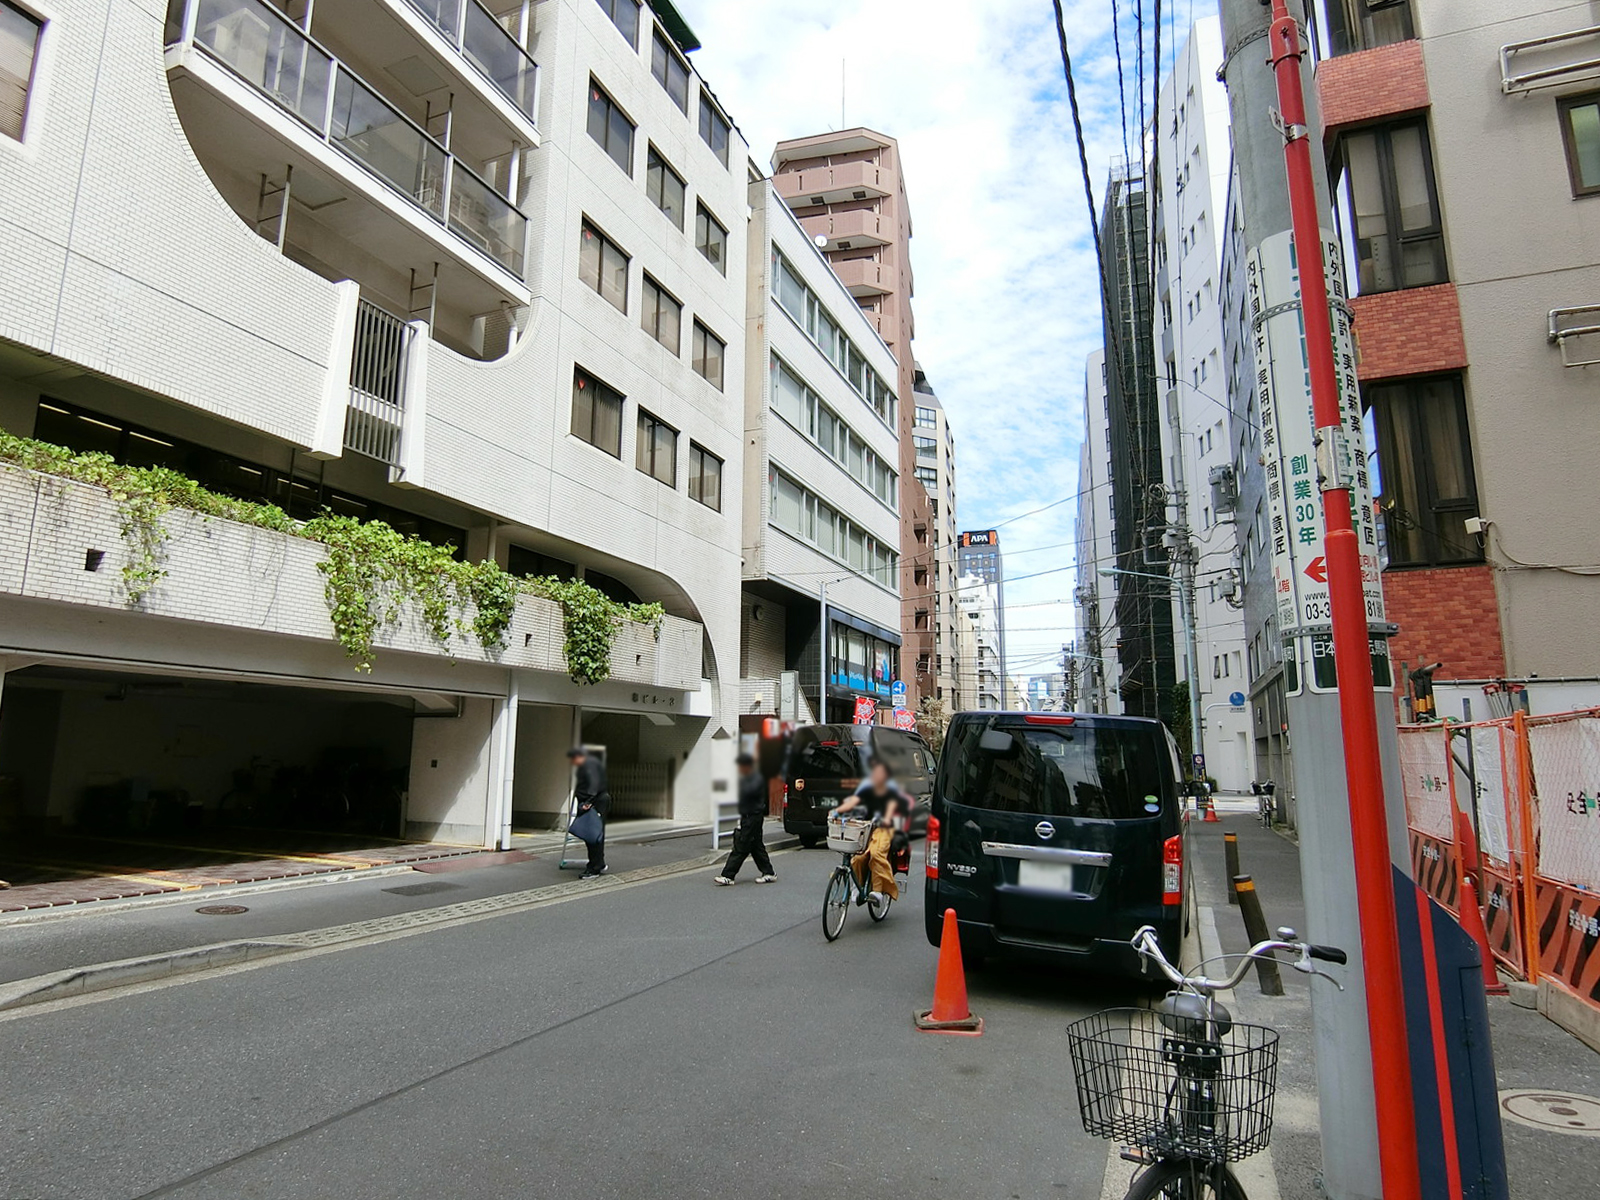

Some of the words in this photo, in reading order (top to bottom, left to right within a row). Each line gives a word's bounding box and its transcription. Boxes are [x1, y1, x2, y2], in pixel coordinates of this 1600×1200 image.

[1291, 453, 1317, 547] 創業30年
[970, 532, 989, 543] APA
